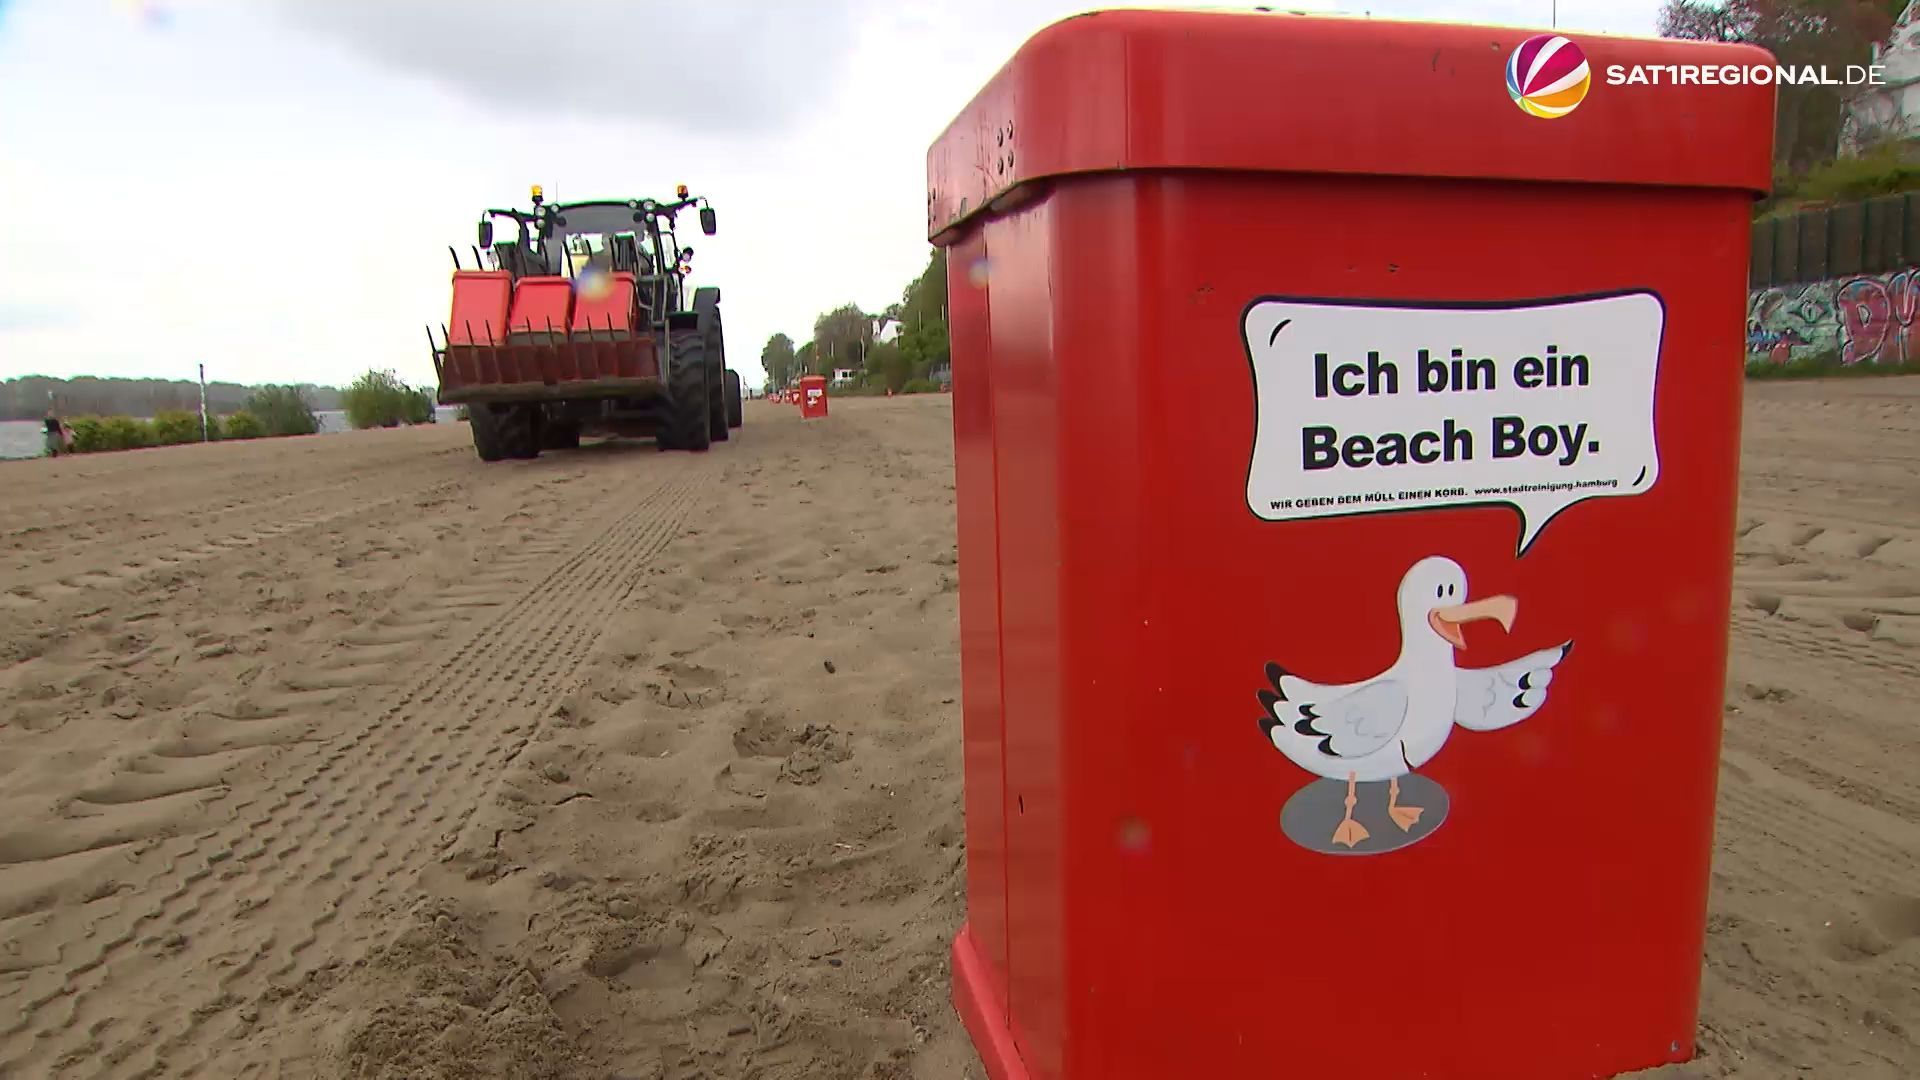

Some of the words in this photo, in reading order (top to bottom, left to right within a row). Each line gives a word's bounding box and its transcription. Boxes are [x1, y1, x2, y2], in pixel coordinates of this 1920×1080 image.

[1313, 351, 1399, 399] Ich
[1417, 348, 1497, 394] bin
[1513, 345, 1590, 389] ein
[1302, 419, 1474, 471] Beach
[1492, 416, 1600, 467] Boy.
[1270, 500, 1293, 510] WIR
[1295, 497, 1334, 508] GEBEN
[1337, 495, 1362, 505] DEM
[1365, 491, 1395, 503] MÜLL
[1398, 489, 1432, 500] EINEN
[1434, 487, 1468, 498] KORB.
[1474, 479, 1618, 495] www.stadtreinigung.hamburg
